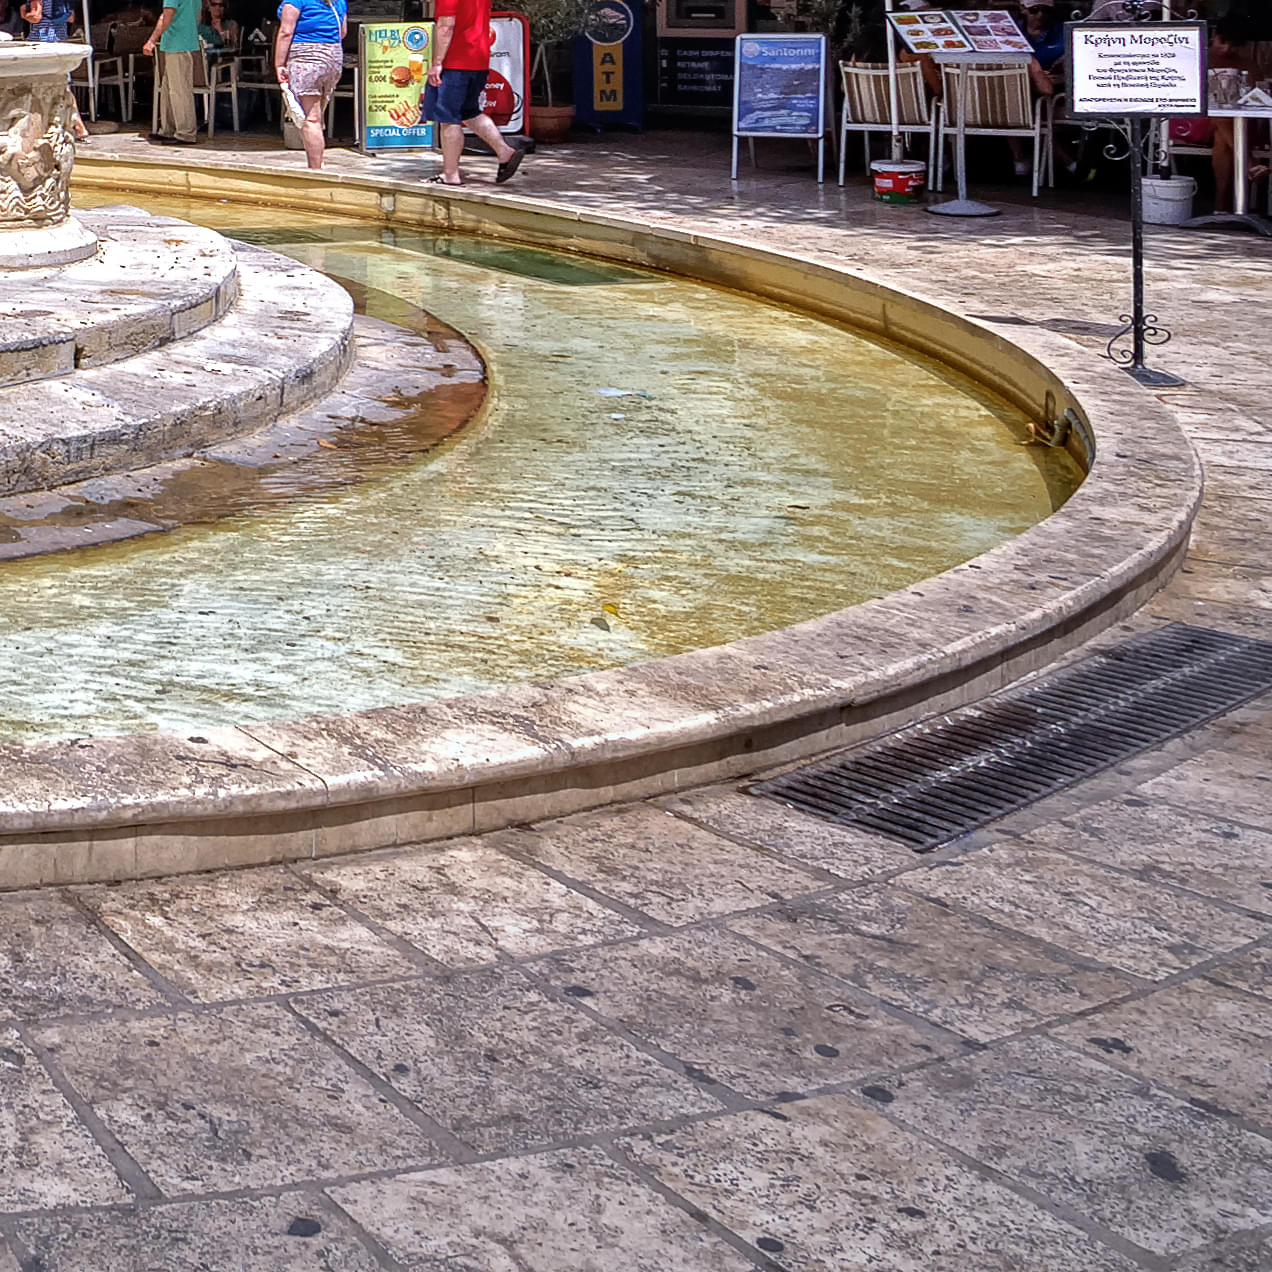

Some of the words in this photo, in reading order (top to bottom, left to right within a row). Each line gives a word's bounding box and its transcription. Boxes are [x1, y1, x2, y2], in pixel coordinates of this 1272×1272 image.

[1083, 33, 1126, 47] Κρήνη
[1129, 33, 1190, 47] Μοροζίνι
[761, 47, 816, 57] Santorini
[599, 52, 618, 103] ATM
[370, 128, 400, 138] SPECIAL
[401, 127, 427, 137] OFFER
